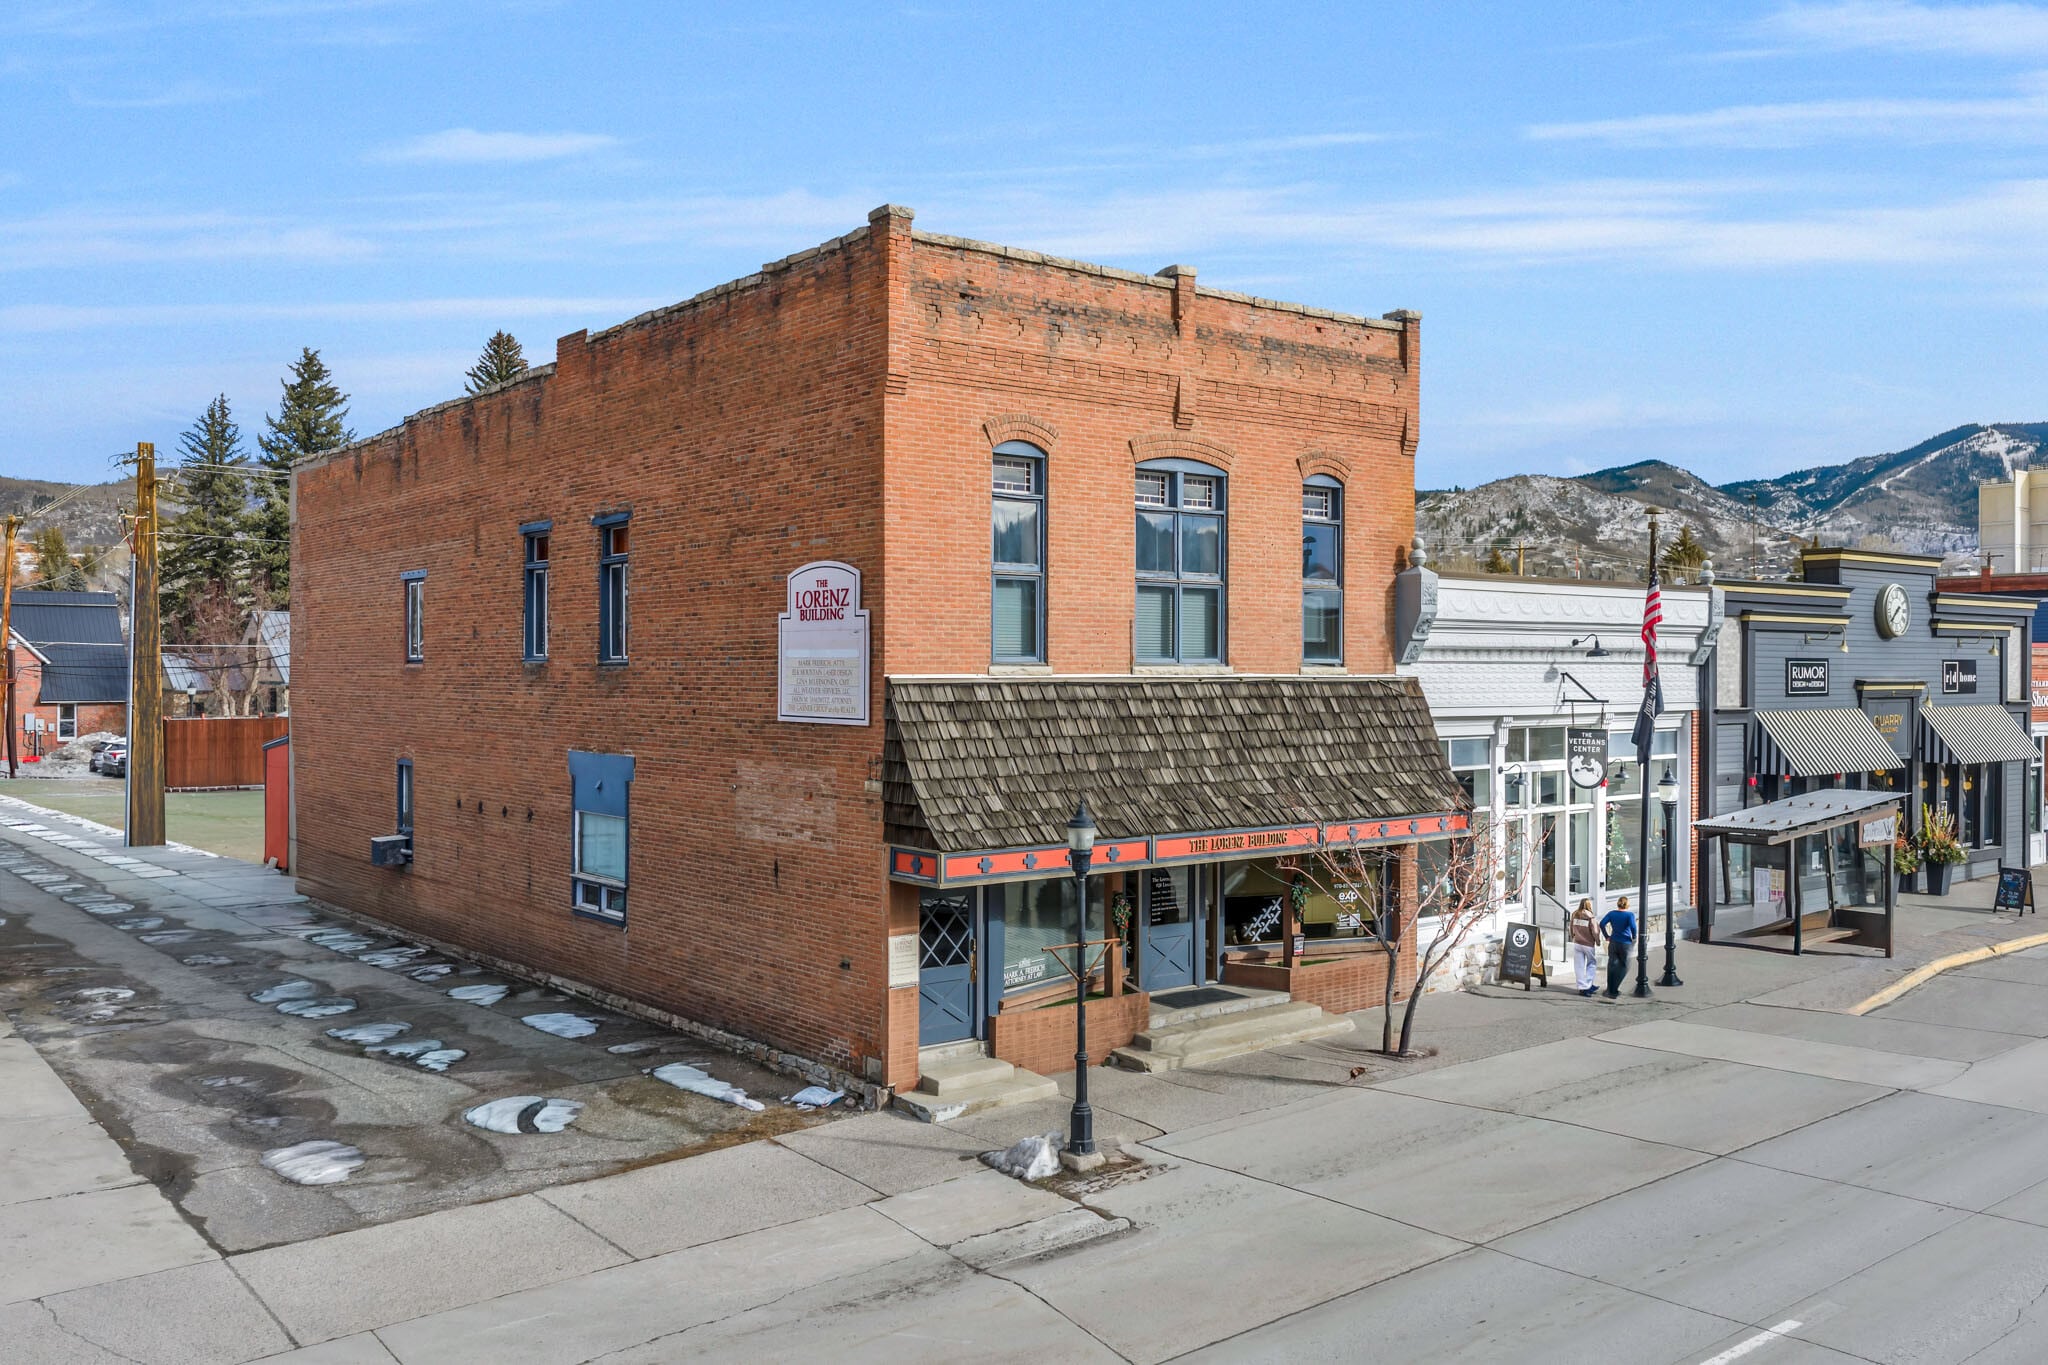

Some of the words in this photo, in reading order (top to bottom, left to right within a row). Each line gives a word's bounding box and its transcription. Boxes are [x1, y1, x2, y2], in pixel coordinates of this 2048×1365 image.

[816, 579, 828, 588] THE
[795, 588, 850, 609] LORENZ
[800, 608, 844, 621] BUILDING
[1792, 666, 1824, 679] RUMOR
[1960, 671, 1976, 683] home
[1873, 713, 1903, 727] QUARRY
[1569, 738, 1606, 746] VETERANS
[1189, 839, 1208, 853] THE
[1210, 835, 1245, 851] LORENZ
[1247, 831, 1288, 848] BUILDING
